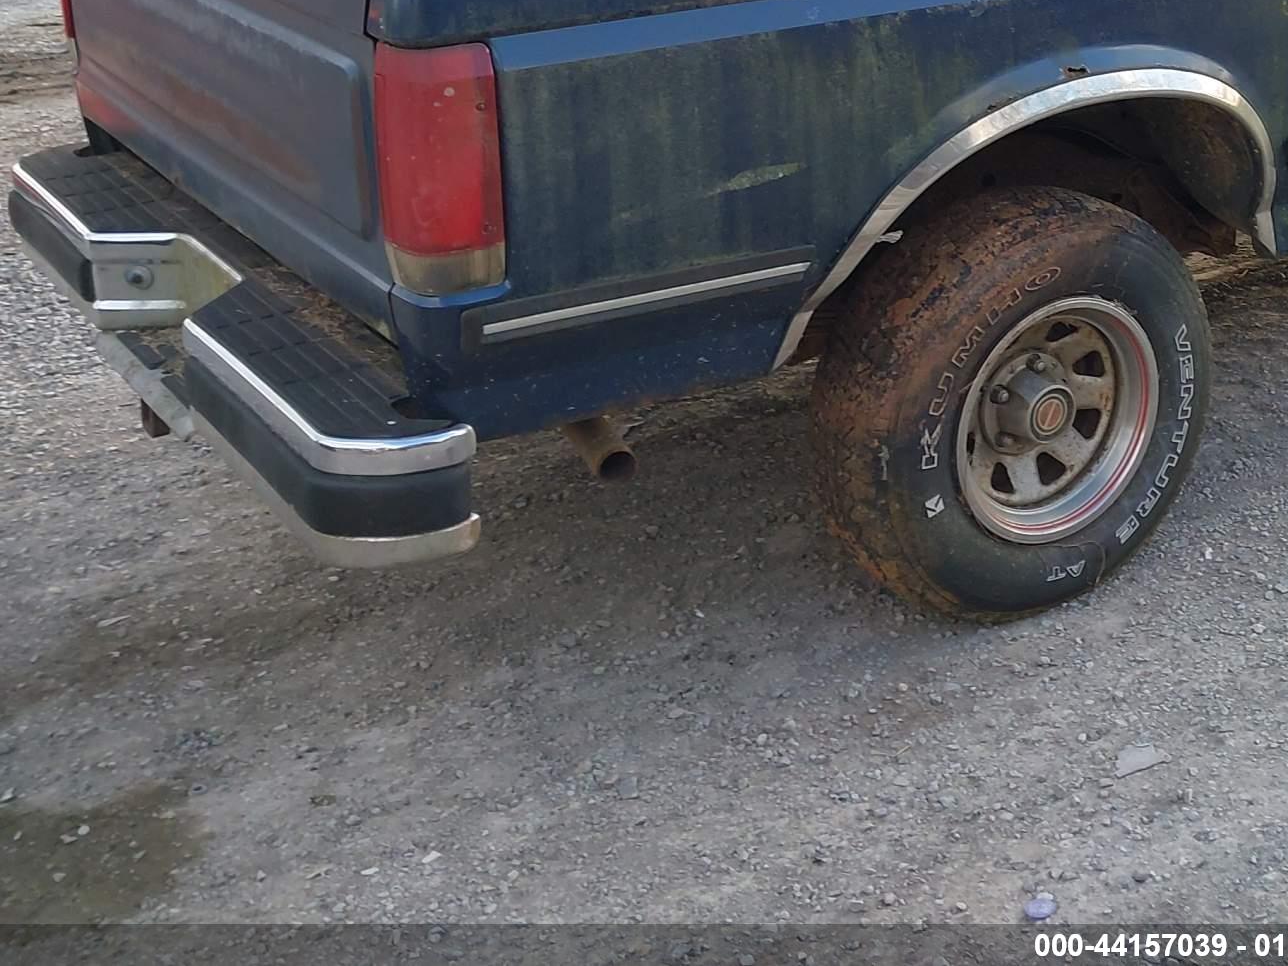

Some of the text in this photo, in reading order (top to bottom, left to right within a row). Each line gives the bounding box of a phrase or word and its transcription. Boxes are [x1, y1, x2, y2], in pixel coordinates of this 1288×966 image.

[920, 266, 1061, 470] KUMHO
[1115, 325, 1195, 546] VENTURE
[1046, 560, 1087, 582] AT
